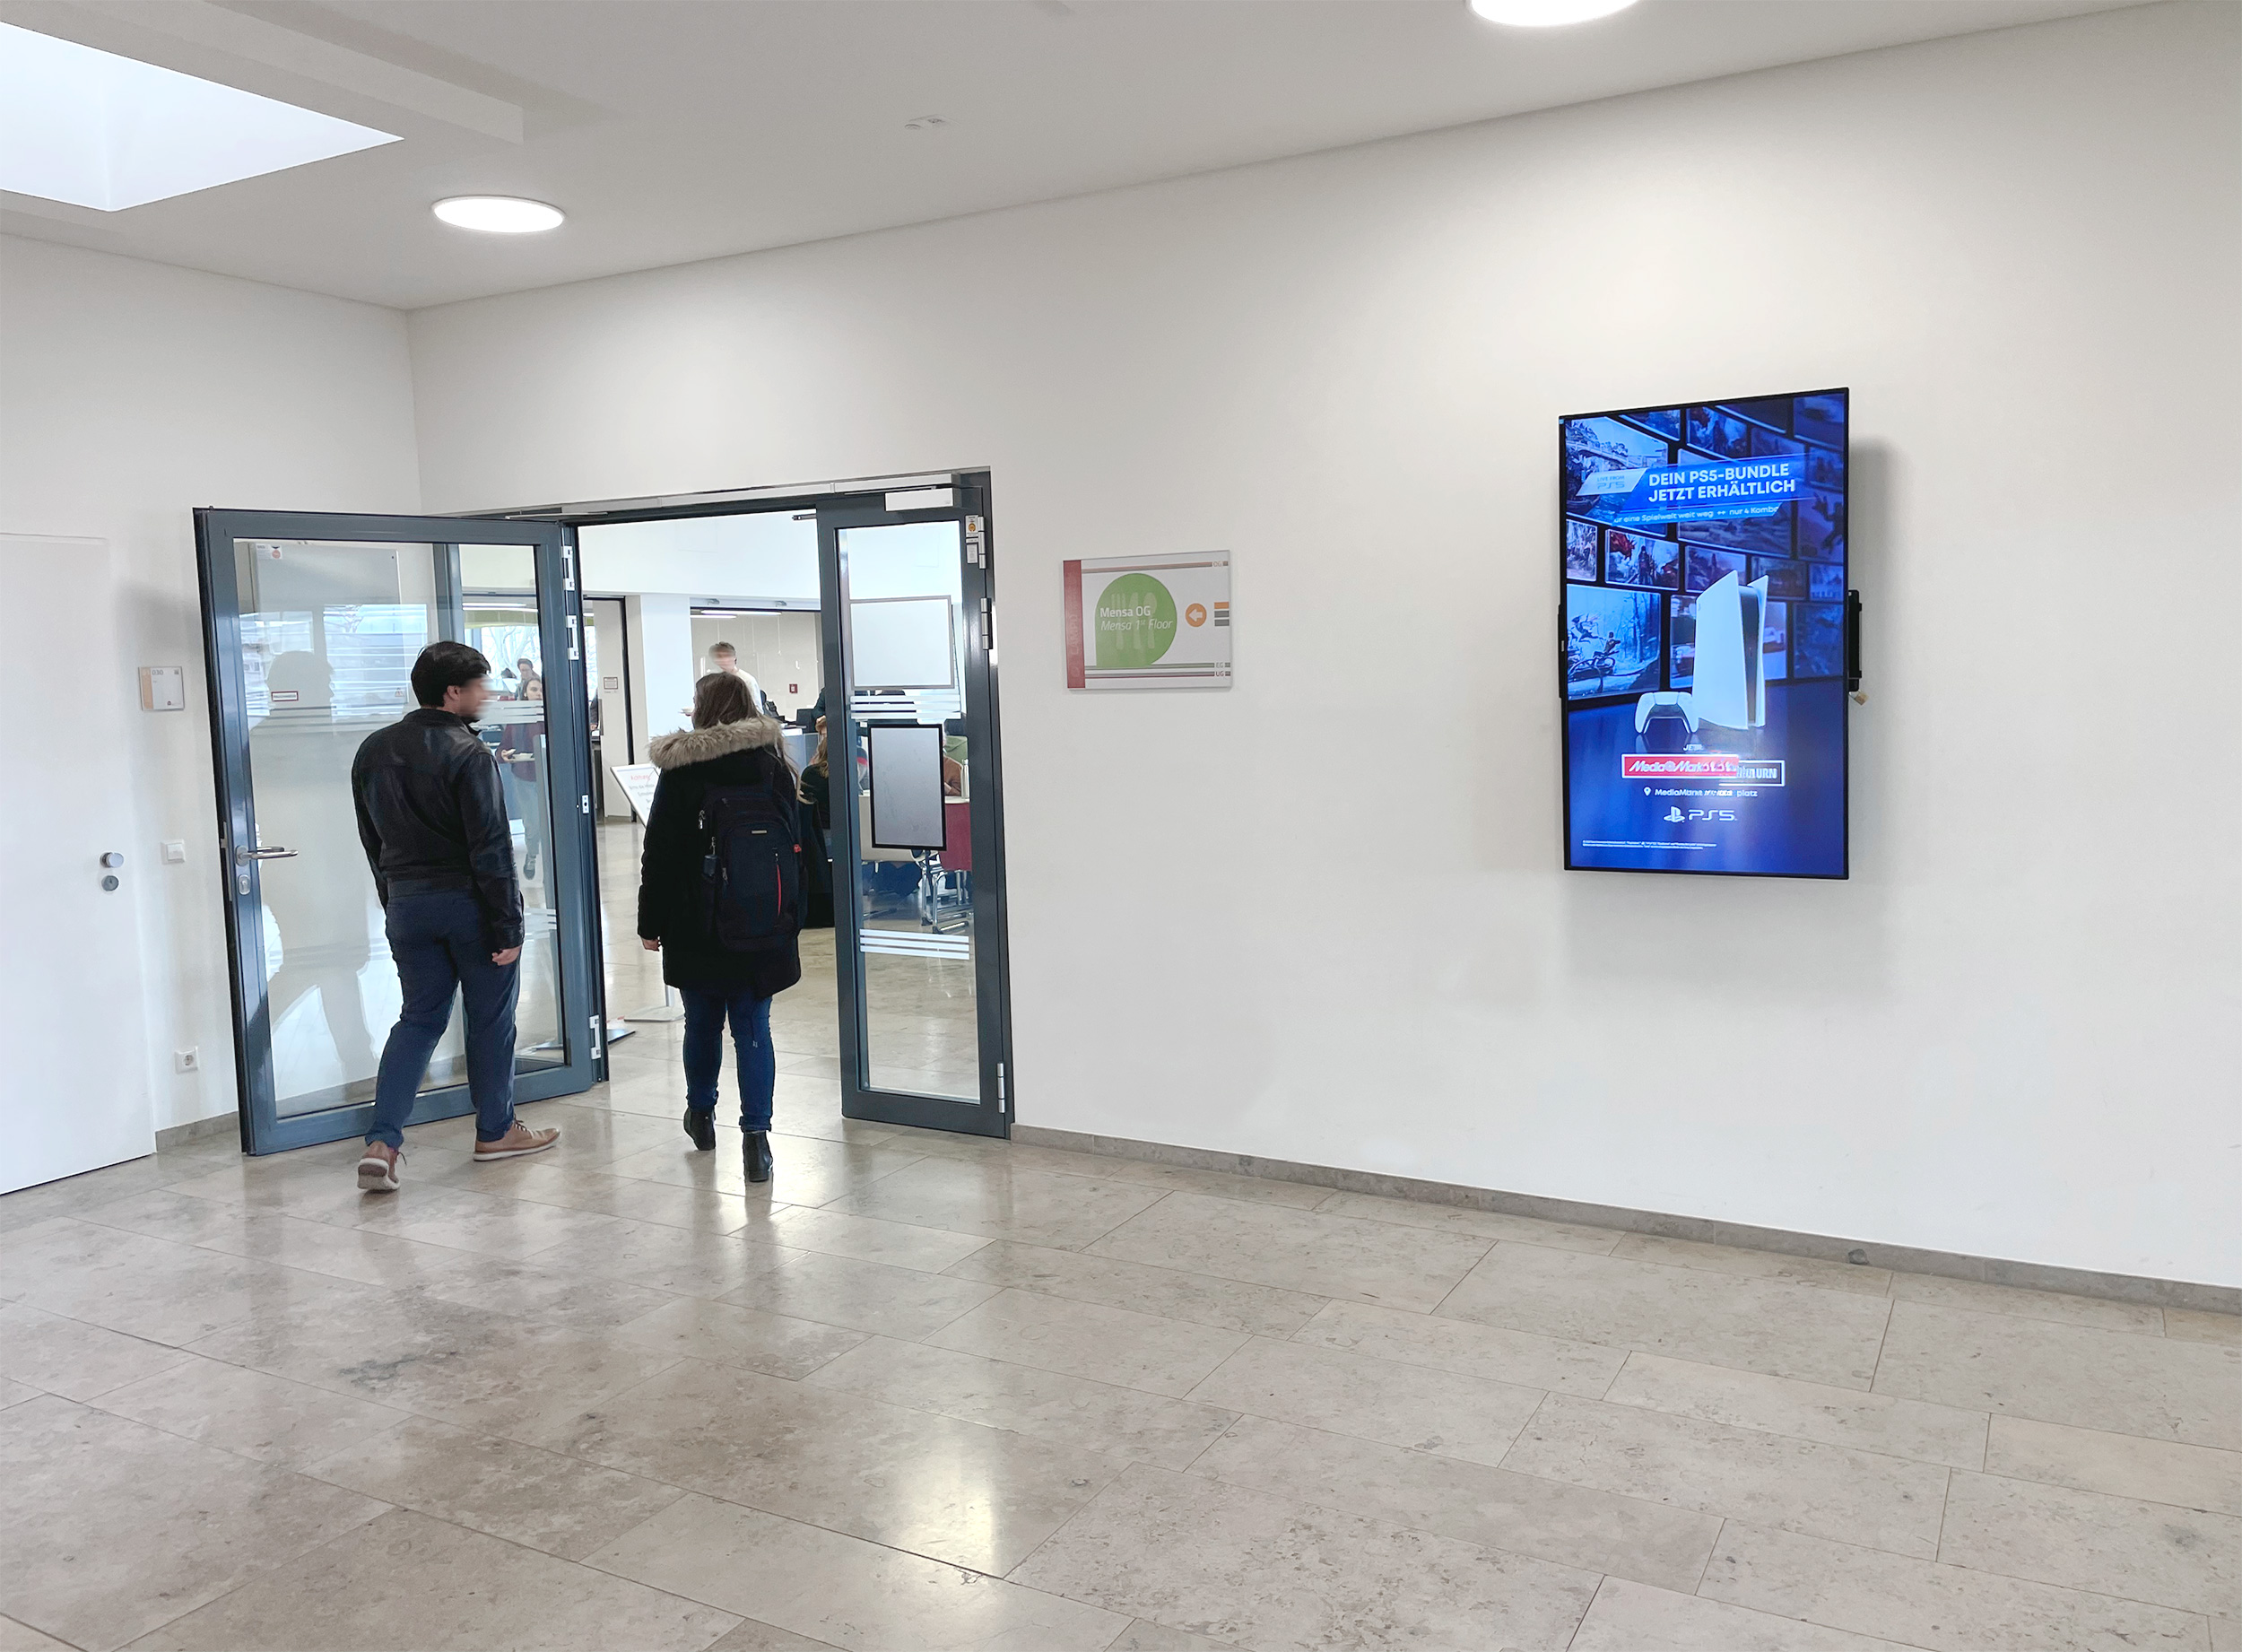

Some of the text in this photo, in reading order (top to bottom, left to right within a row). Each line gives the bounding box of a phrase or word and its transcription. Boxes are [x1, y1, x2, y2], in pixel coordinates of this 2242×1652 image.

[1649, 463, 1789, 486] DEIN PS5-BUNDLE
[1596, 481, 1625, 490] PS5
[1648, 479, 1795, 502] JETZT ERHÄLTLICH
[1099, 605, 1151, 618] Mensa OG
[1100, 618, 1173, 630] Mensa 1st Floor
[1689, 810, 1735, 822] PS5
